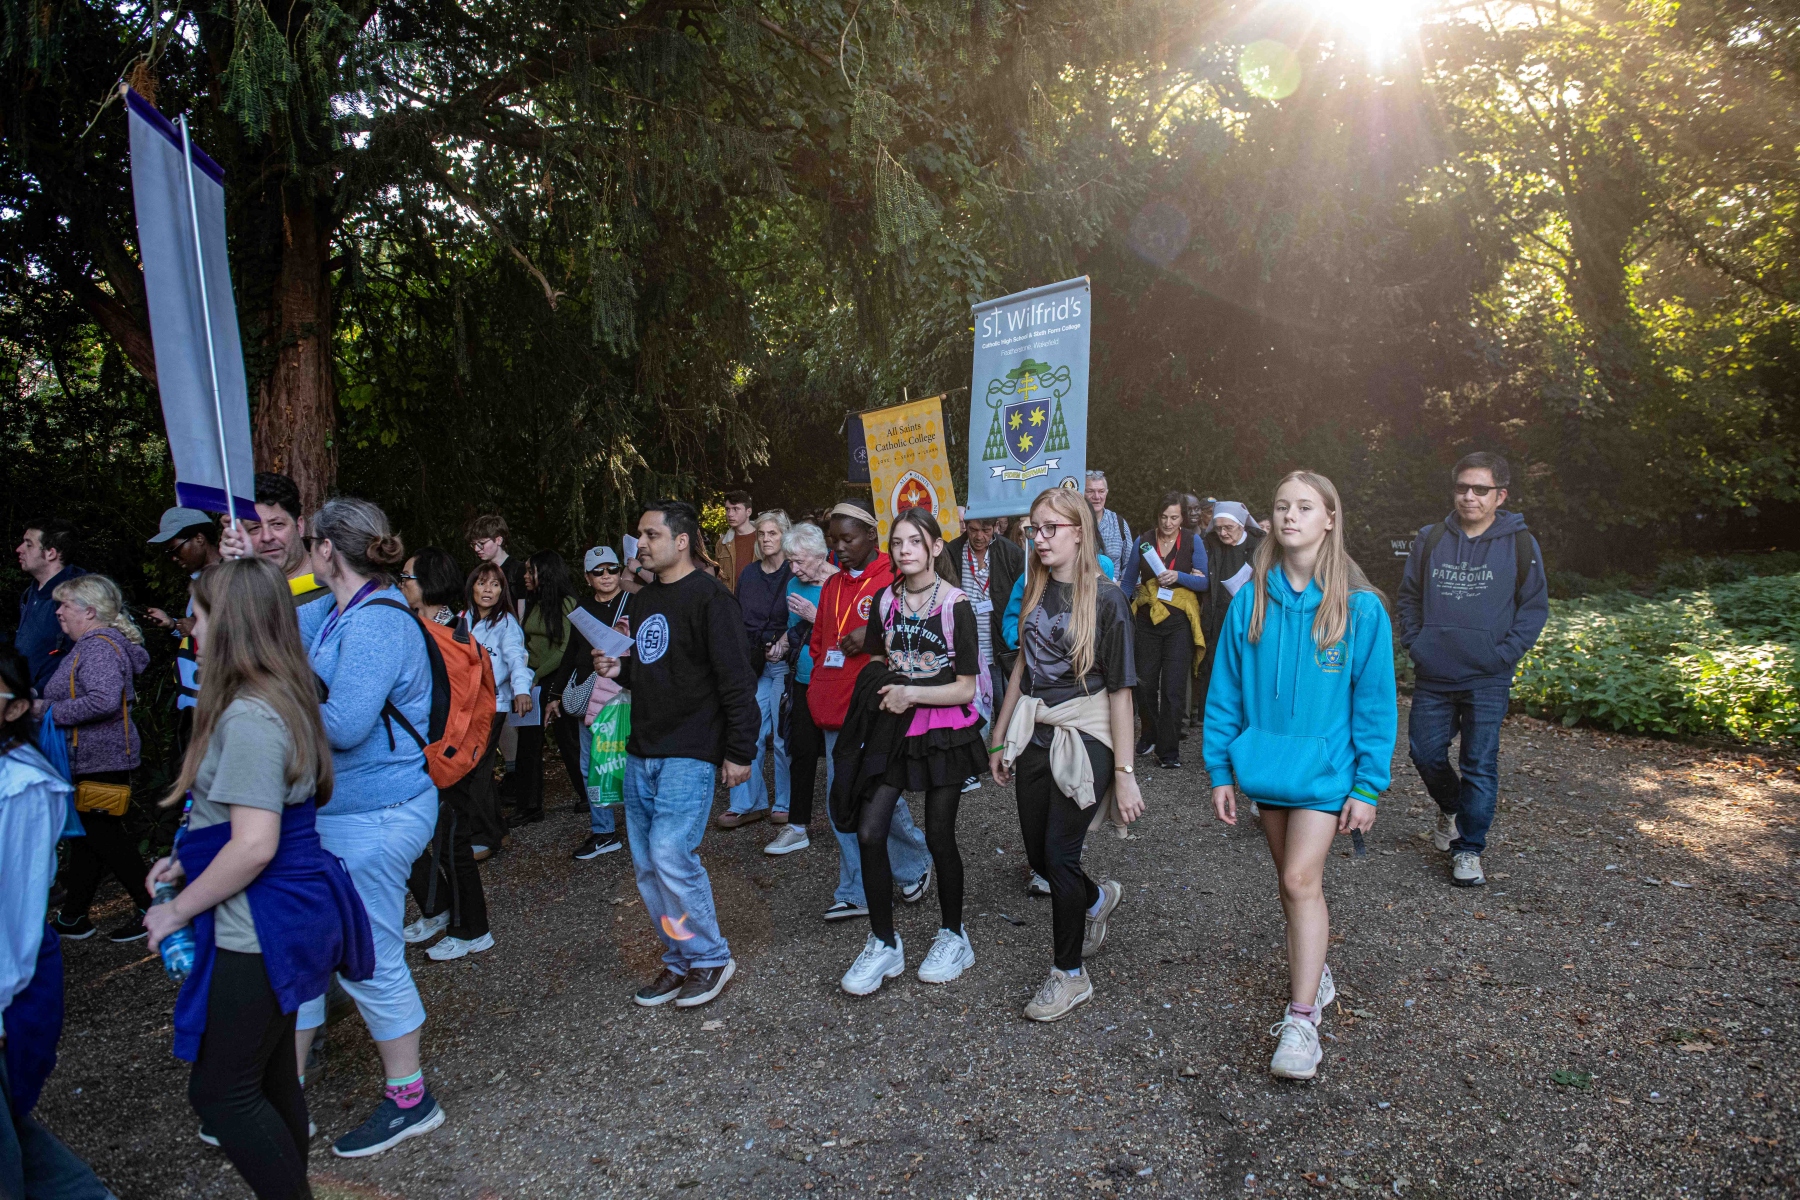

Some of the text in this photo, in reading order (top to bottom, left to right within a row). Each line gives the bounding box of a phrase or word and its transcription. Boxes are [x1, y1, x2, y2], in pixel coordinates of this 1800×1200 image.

[1007, 296, 1082, 332] Wilfrid's
[982, 341, 1000, 350] Catholic
[1001, 338, 1012, 346] High
[1013, 334, 1028, 343] School
[1033, 330, 1046, 338] Sixth
[1047, 327, 1061, 335] Form
[1062, 323, 1081, 332] College
[1034, 338, 1059, 350] Wakefield
[887, 423, 921, 438] All Saints
[875, 433, 936, 453] Catholic College
[899, 473, 930, 487] ALL SAINTS
[1391, 540, 1408, 550] WAY
[1432, 568, 1494, 582] PATAGONIA
[646, 630, 660, 639] FC
[896, 624, 920, 634] WHAT
[921, 628, 938, 643] YOU
[595, 753, 627, 776] with
